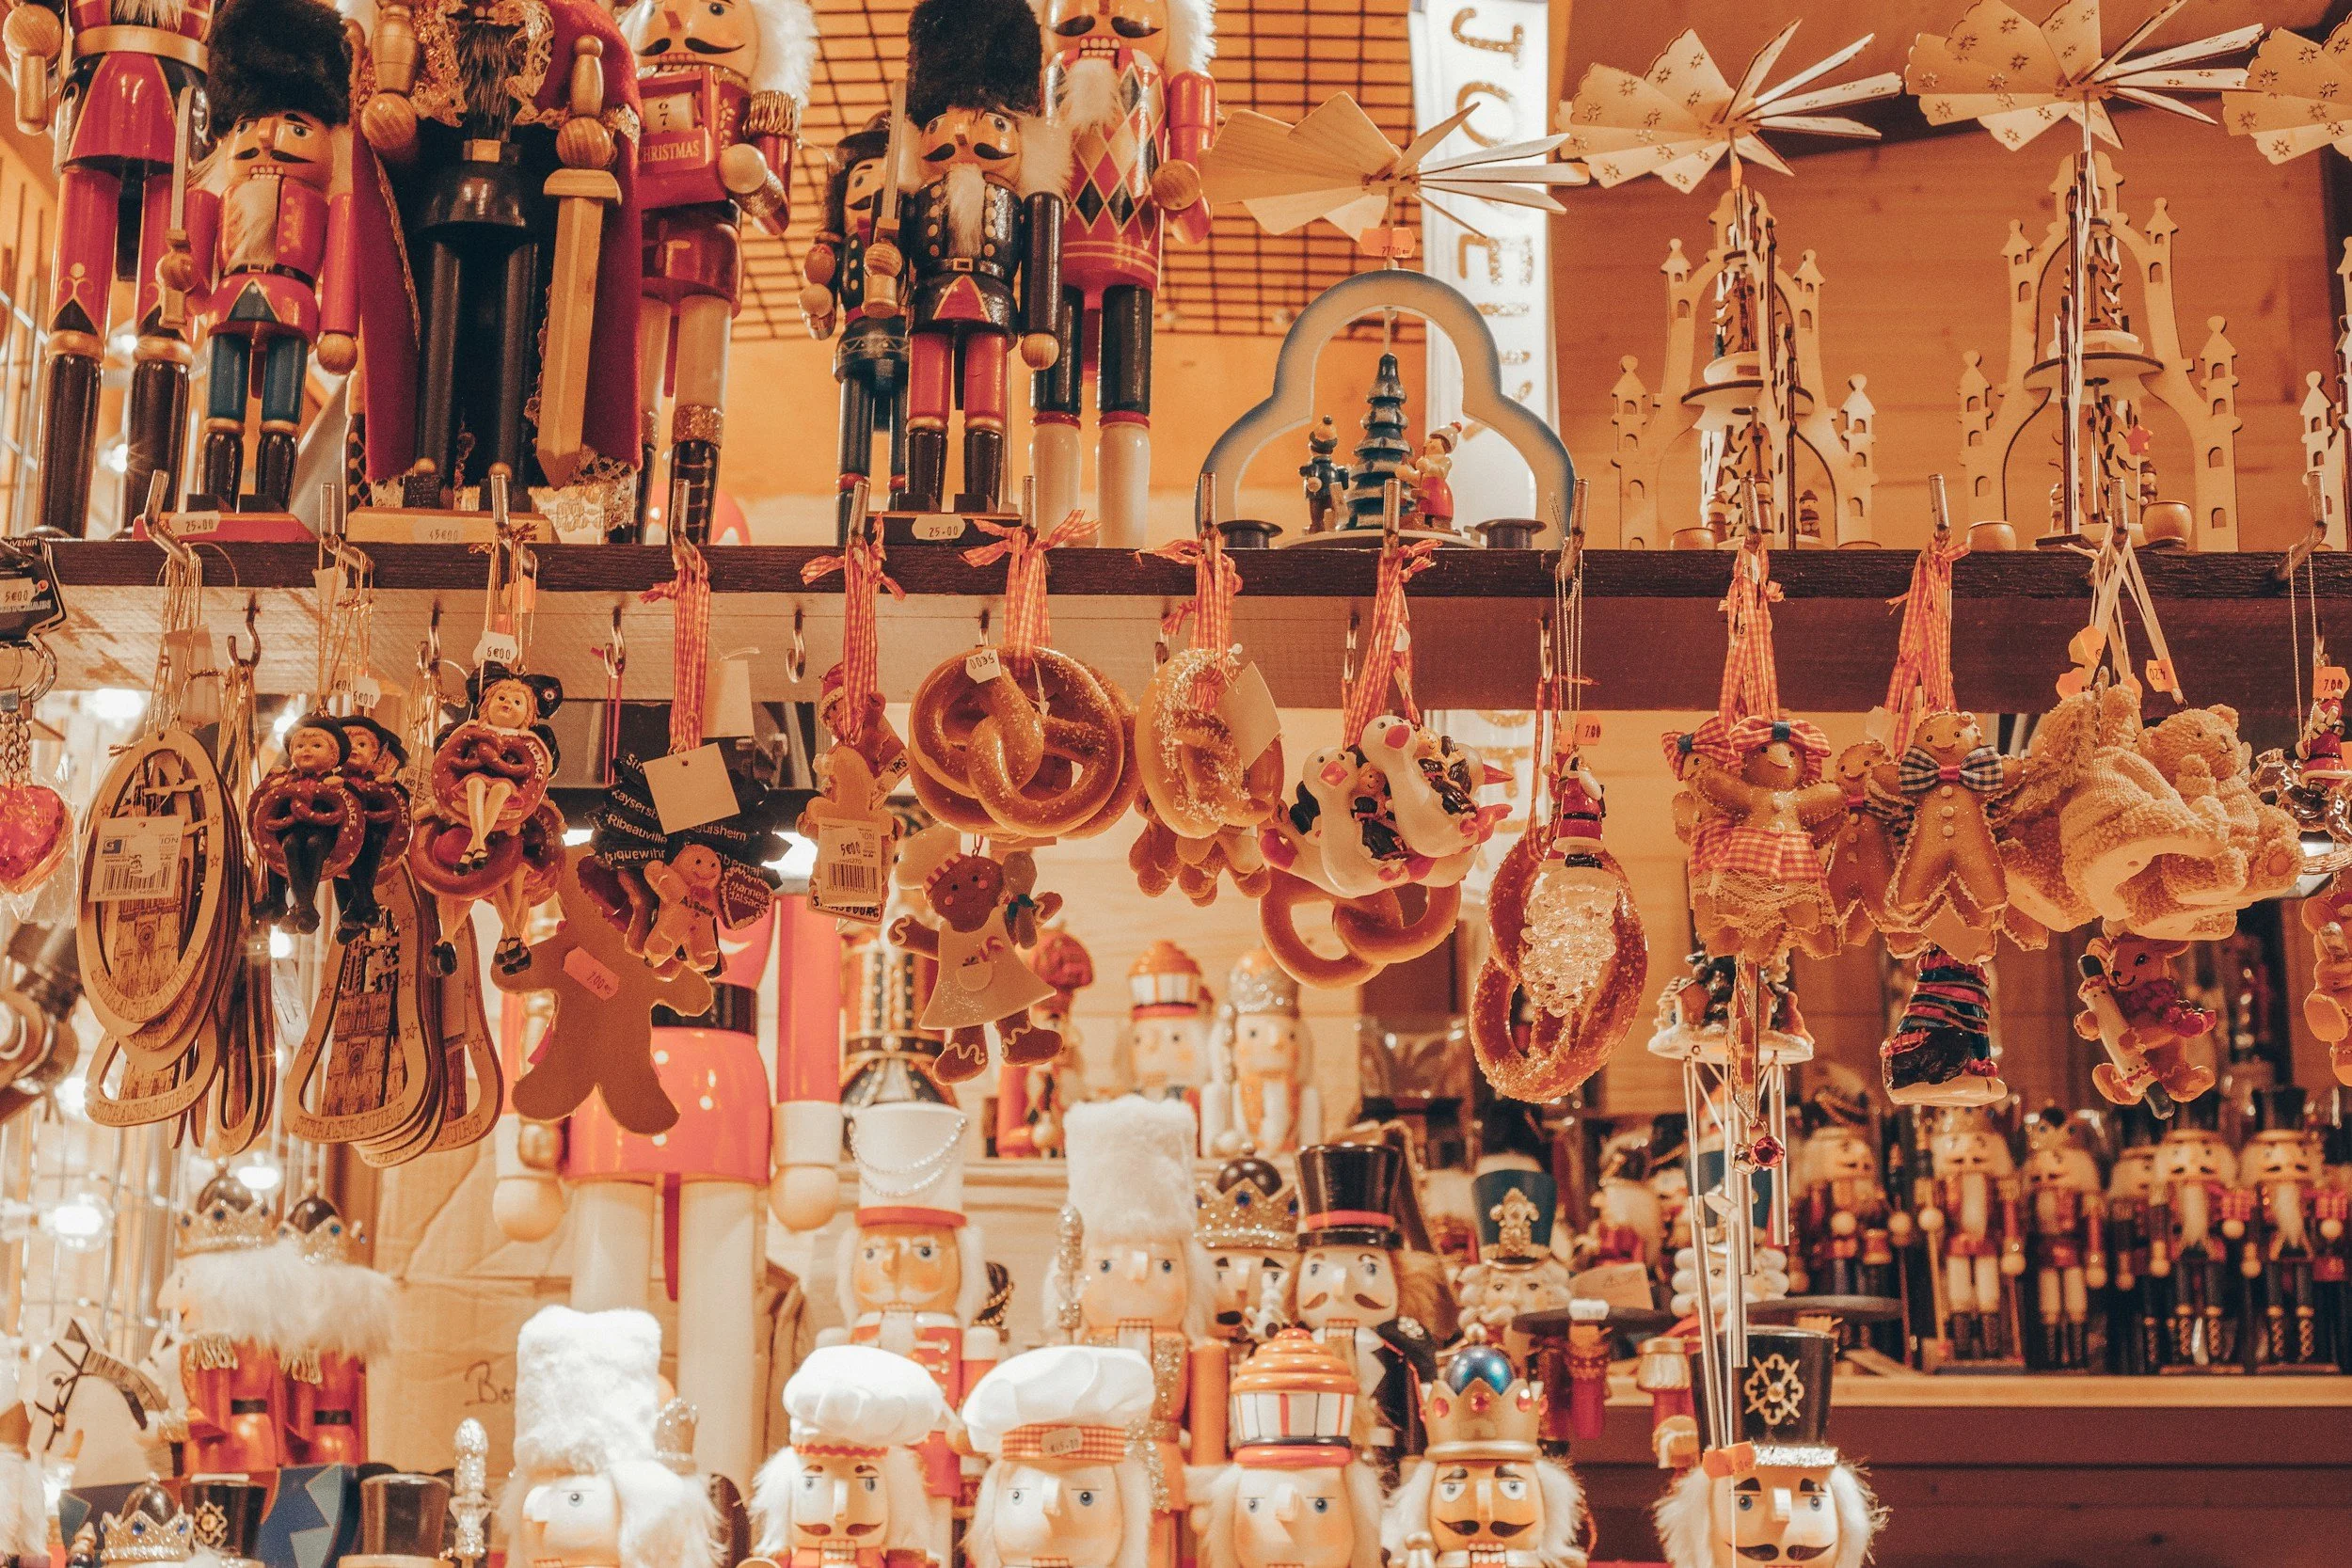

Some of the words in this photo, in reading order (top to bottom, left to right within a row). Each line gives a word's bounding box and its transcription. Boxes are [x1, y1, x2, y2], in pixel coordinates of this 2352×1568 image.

[5, 590, 28, 603] 5€00
[486, 646, 511, 660] 6€00
[353, 690, 374, 706] 6€00
[526, 740, 543, 781] ALSACE
[337, 787, 358, 828] ALSACE
[390, 786, 410, 827] ALSACE
[690, 823, 748, 842] guisheim
[840, 841, 861, 857] 5€00
[813, 895, 880, 918] SBOURG
[293, 1101, 406, 1140] STRASBOURG
